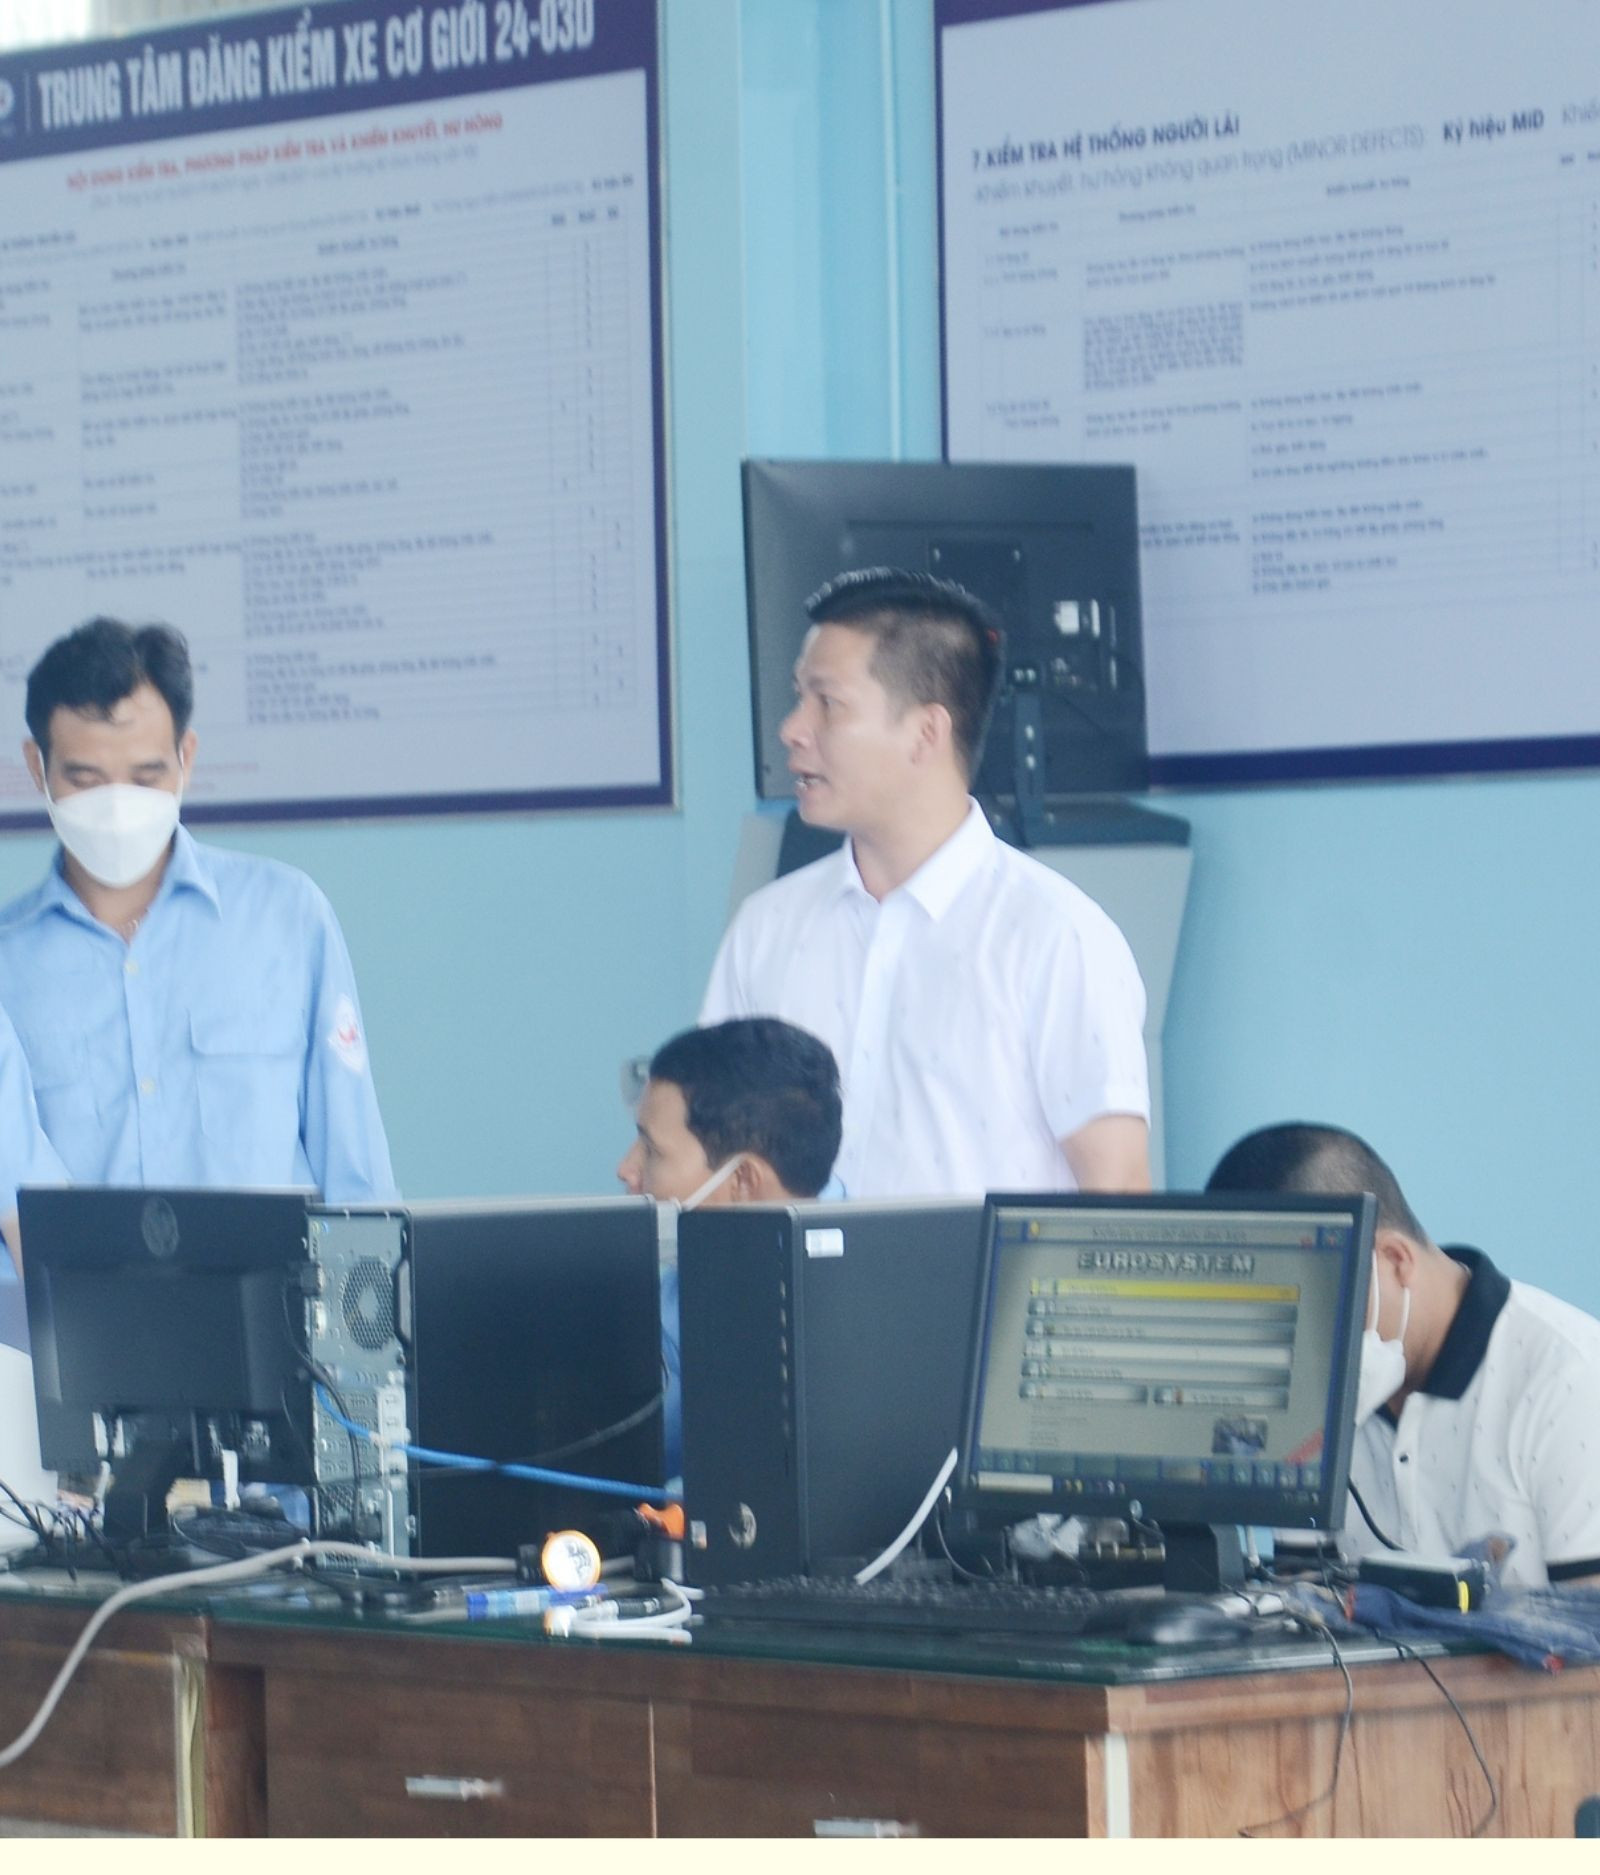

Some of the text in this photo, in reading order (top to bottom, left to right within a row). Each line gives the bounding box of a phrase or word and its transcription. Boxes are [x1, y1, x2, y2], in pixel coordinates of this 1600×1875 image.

[38, 0, 595, 130] TRUNG TÂM ĐĂNG KIỂM XE CƠ GIỚI 24-03D
[972, 109, 1240, 171] 7.KIỂM TRA HỆ THỐNG NGƯỜI LÁI
[1442, 117, 1463, 144] Ký
[1469, 112, 1506, 142] hiệu
[1078, 1250, 1256, 1276] EUROSYSTEM
